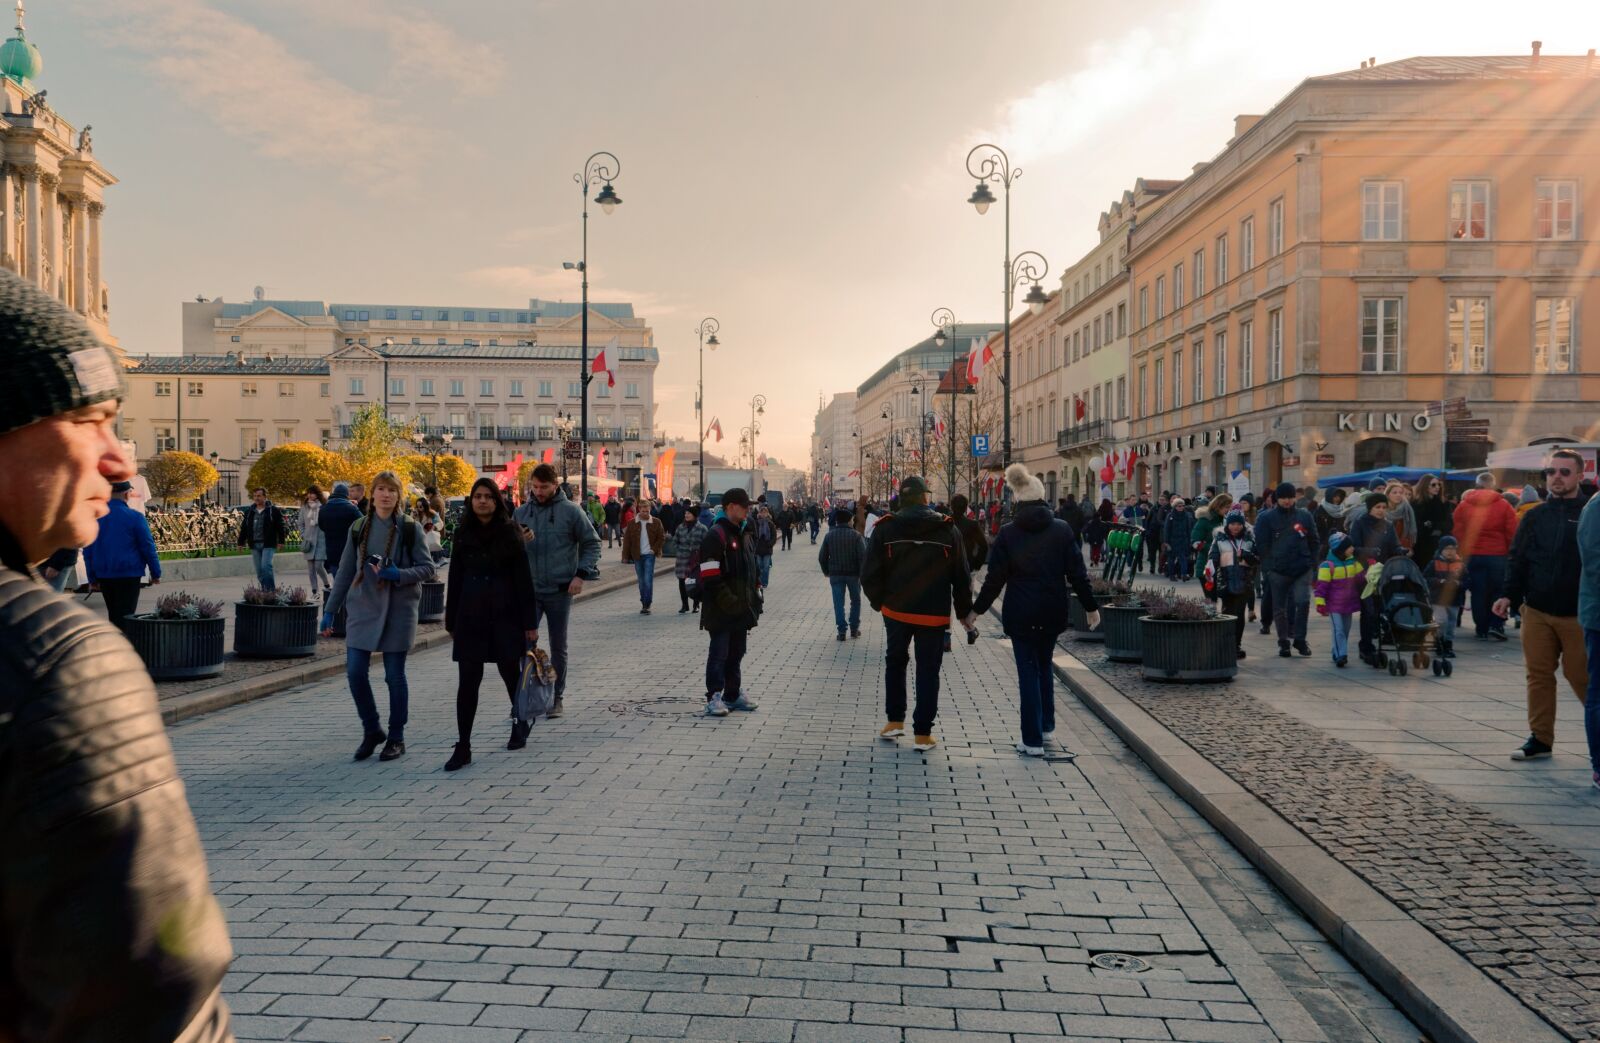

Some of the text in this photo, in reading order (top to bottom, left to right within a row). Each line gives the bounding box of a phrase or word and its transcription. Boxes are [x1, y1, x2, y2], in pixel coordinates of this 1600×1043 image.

[1338, 412, 1431, 432] KINO
[975, 436, 986, 450] P
[1152, 426, 1239, 455] KULTURA
